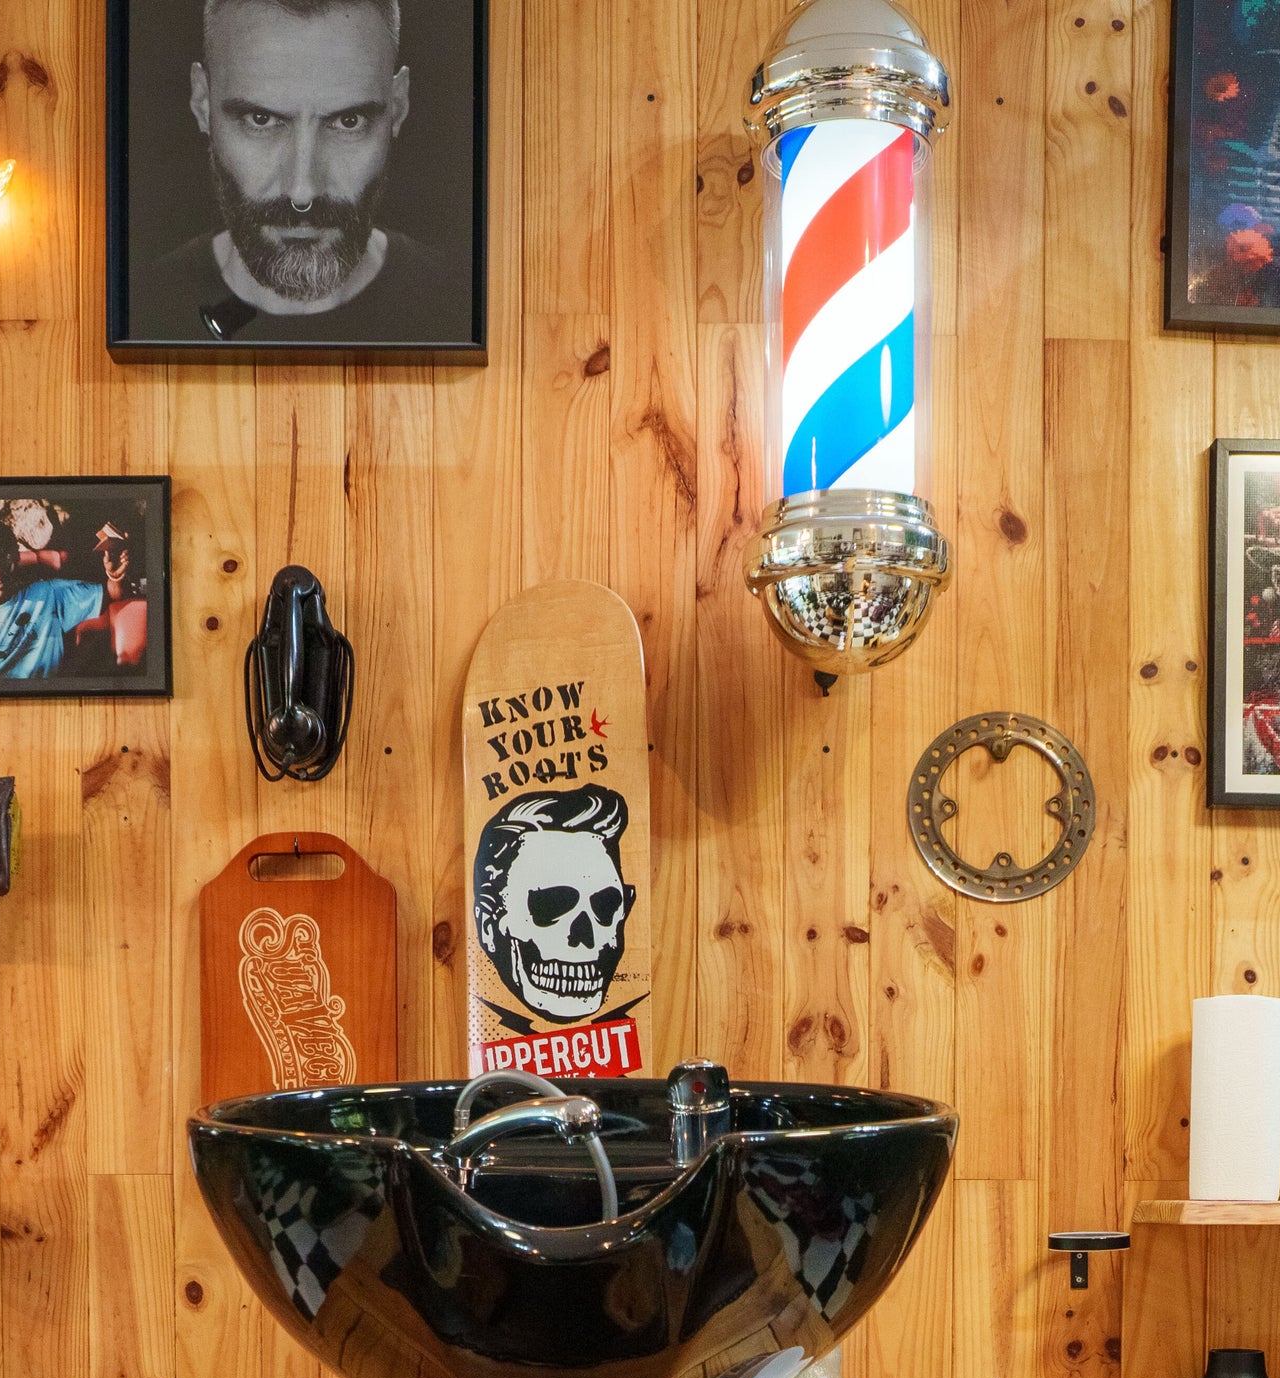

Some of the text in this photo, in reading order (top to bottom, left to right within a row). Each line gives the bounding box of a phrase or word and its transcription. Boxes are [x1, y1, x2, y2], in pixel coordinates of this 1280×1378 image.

[478, 681, 585, 727] KNOW
[487, 715, 587, 762] YOUR
[481, 744, 608, 801] ROOTS
